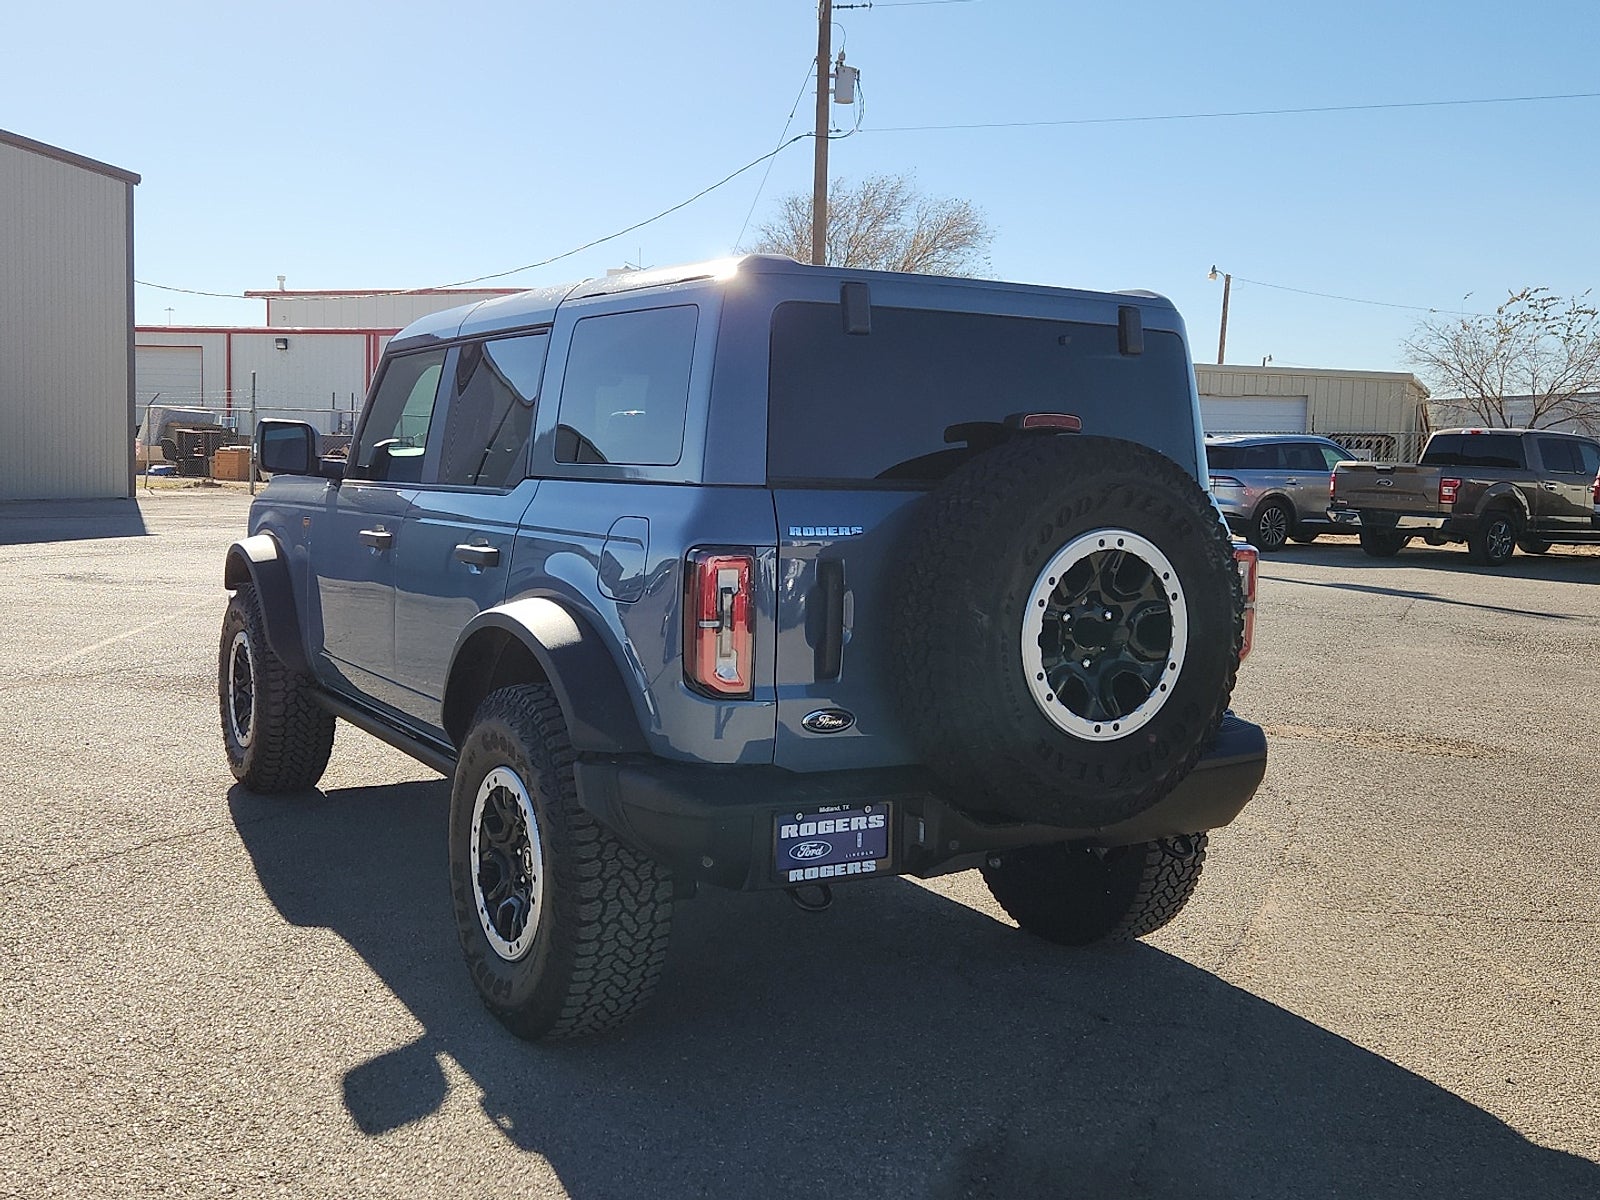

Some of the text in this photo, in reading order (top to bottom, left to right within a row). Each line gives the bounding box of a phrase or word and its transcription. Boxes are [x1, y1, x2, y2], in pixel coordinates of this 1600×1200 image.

[788, 526, 863, 536] ROGERS
[780, 814, 885, 839] ROGERS
[796, 842, 825, 858] Ford
[845, 850, 874, 859] LINCOLN
[788, 859, 877, 882] ROGERS
